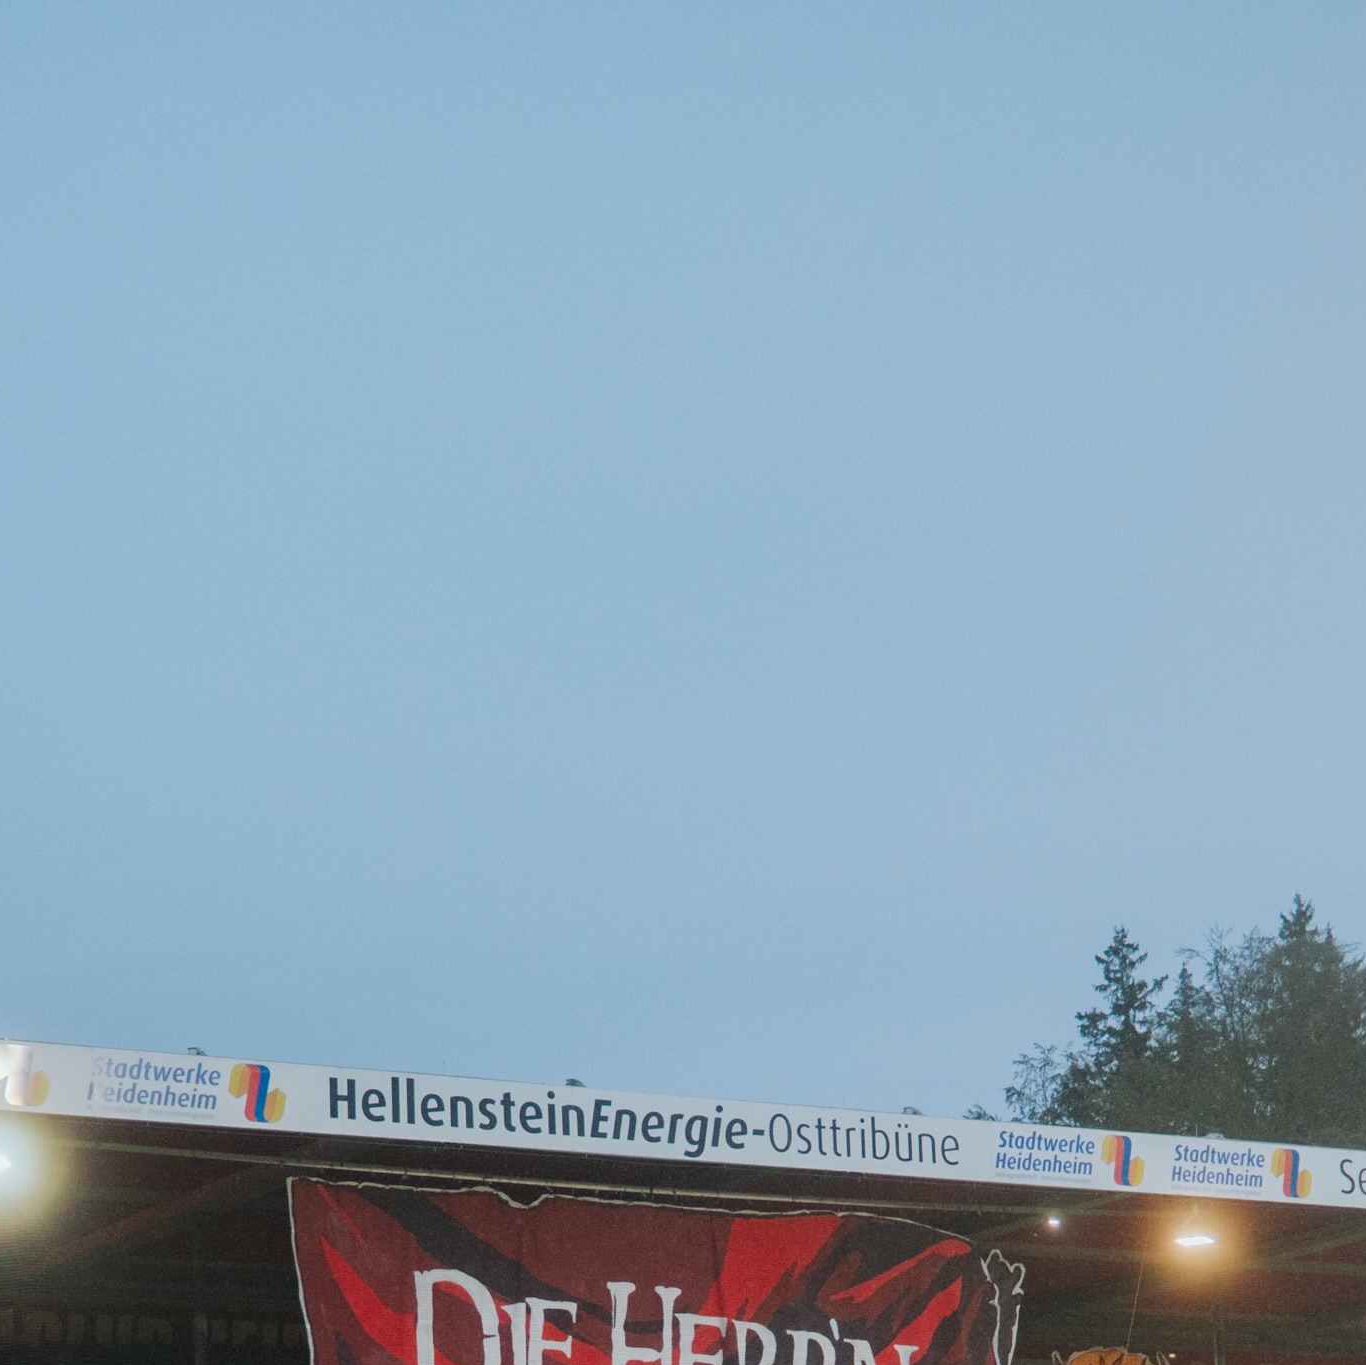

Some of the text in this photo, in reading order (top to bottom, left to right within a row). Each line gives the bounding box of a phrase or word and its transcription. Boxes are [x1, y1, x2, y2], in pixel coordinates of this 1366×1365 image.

[94, 1057, 222, 1087] Stadtwerke
[87, 1081, 218, 1111] Heidenheim
[328, 1076, 961, 1167] HellensteinEnergie-Osttribüne
[997, 1130, 1096, 1155] Stadtwerke
[995, 1152, 1093, 1176] Heidenheim
[1173, 1144, 1266, 1168] Stadtwerke
[1171, 1165, 1264, 1188] Heidenheim
